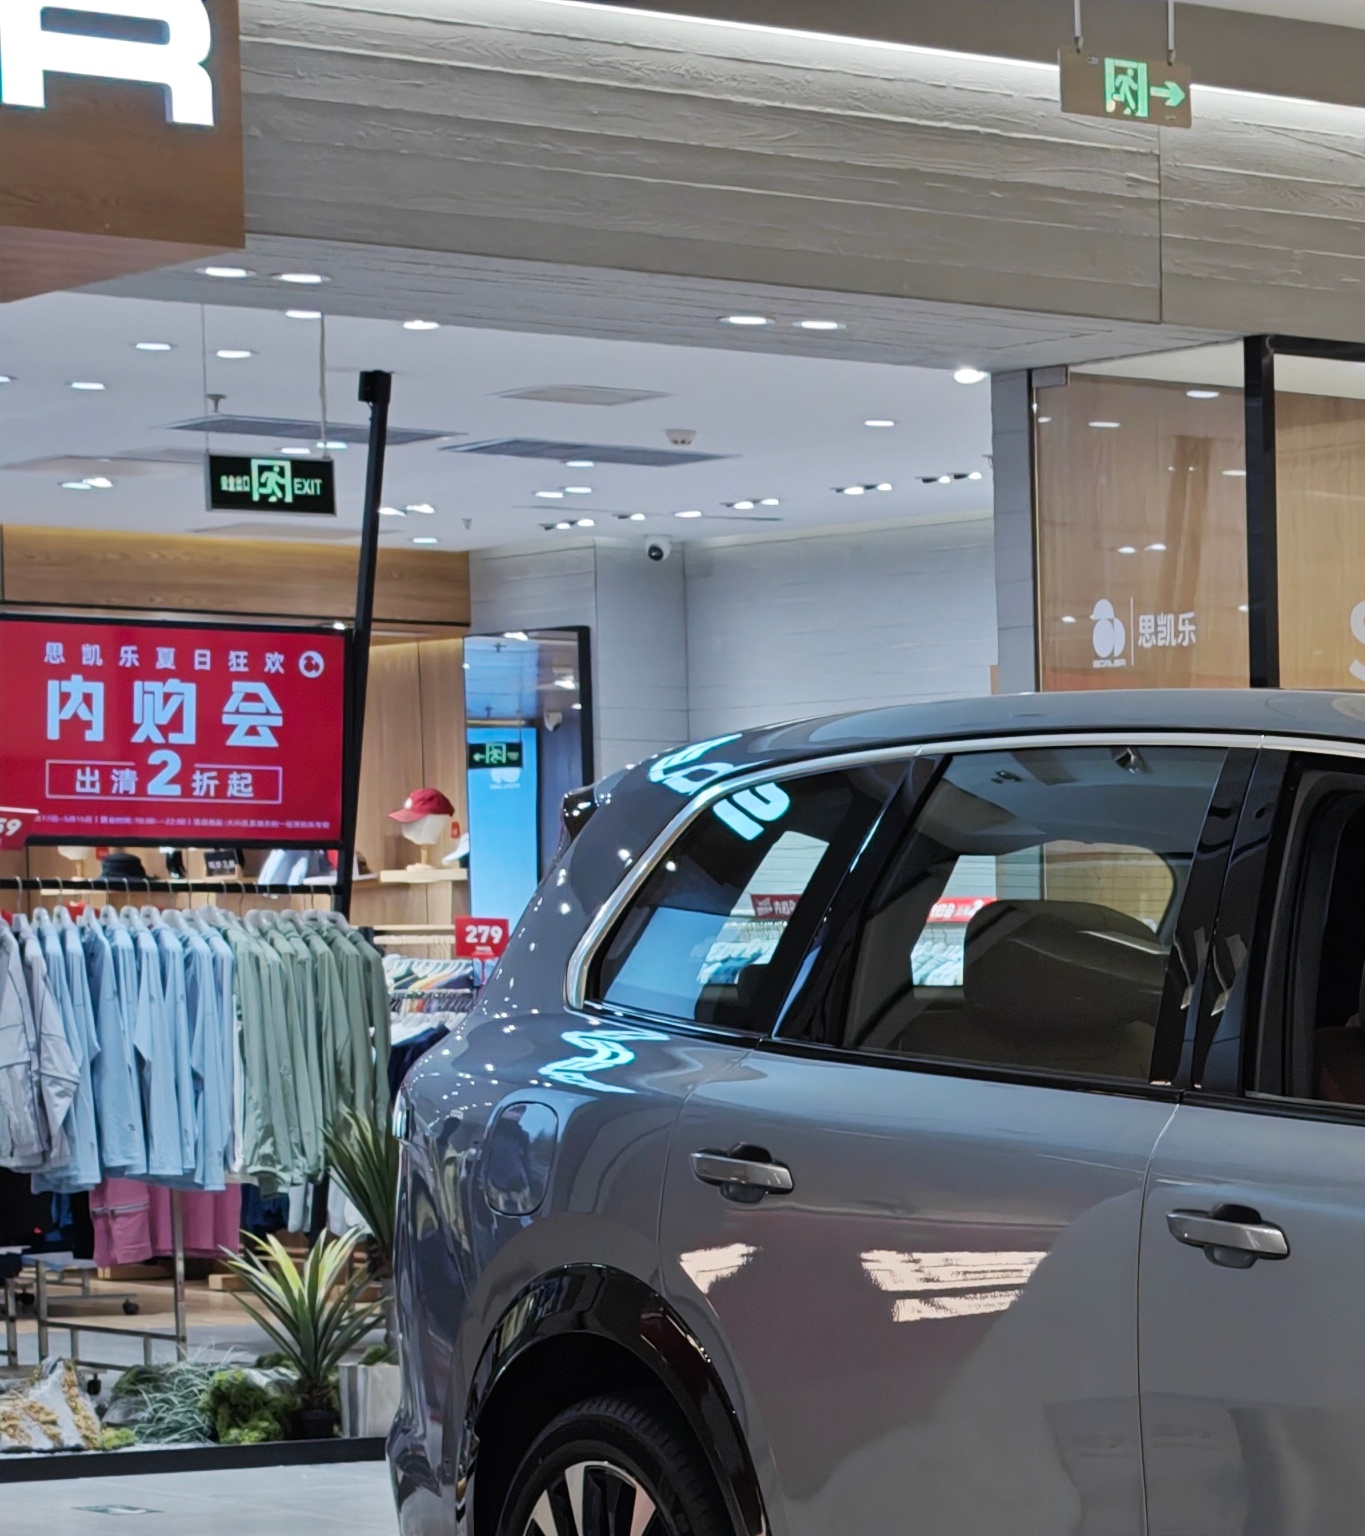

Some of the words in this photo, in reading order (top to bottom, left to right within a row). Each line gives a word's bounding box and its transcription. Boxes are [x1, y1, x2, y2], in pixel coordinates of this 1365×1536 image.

[294, 478, 323, 495] EXIT
[1138, 612, 1197, 648] 思凯乐
[44, 641, 285, 674] 思凯乐夏日狂欢
[46, 674, 284, 748] 内购会
[75, 749, 255, 797] 出清2折起
[465, 925, 503, 944] 279
